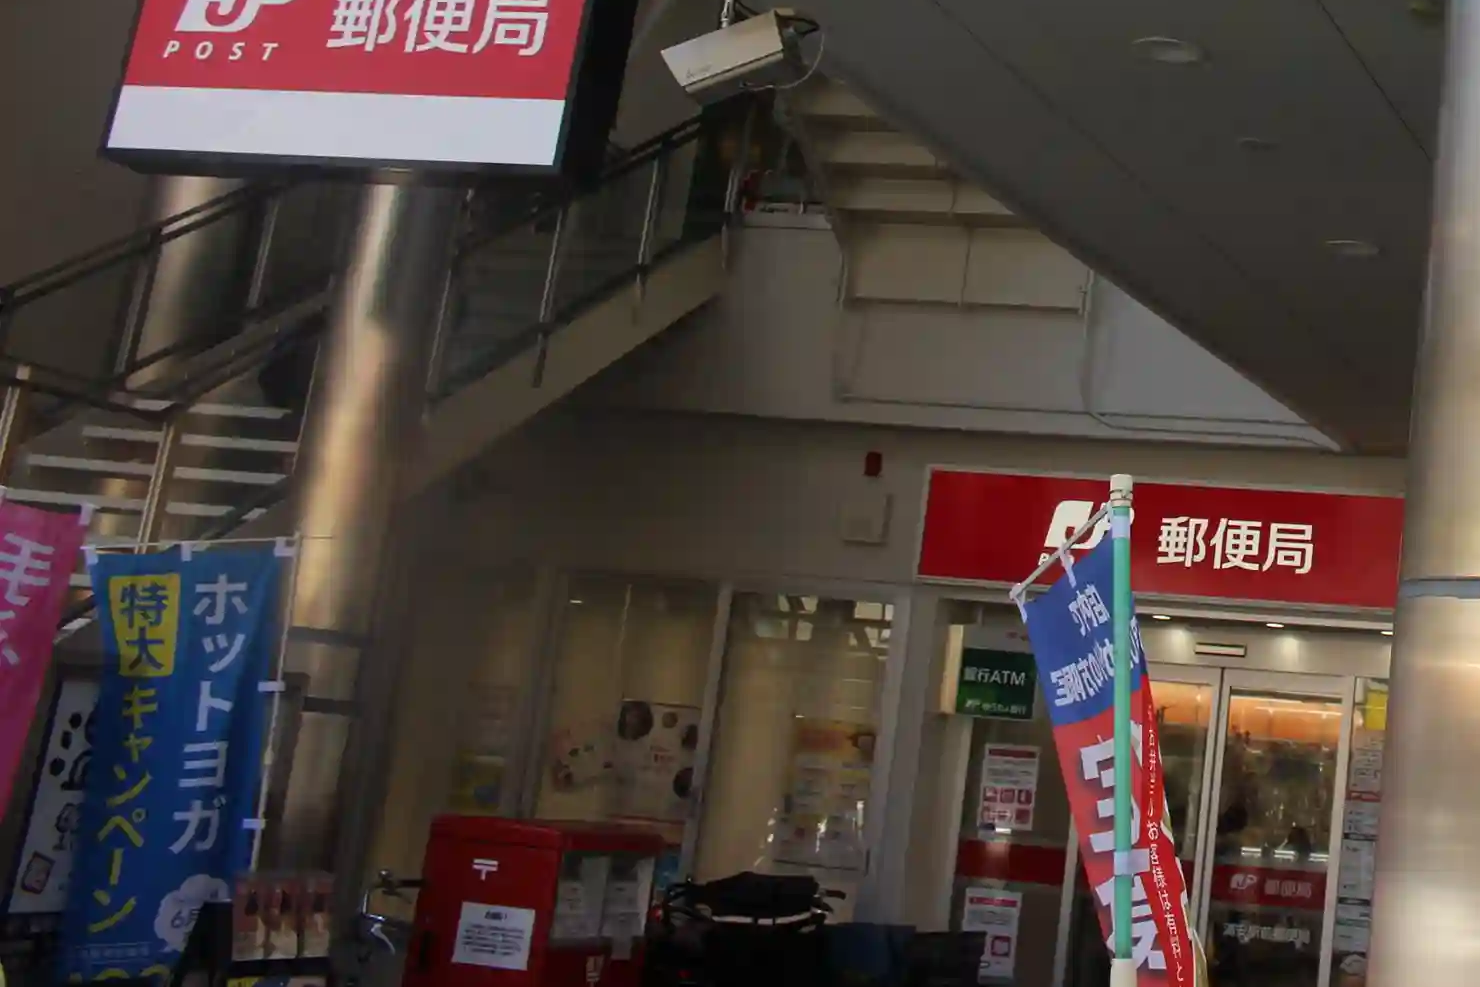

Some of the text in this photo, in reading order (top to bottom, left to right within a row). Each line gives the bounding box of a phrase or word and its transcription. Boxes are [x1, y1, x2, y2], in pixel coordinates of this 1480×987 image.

[163, 41, 278, 60] POST
[1157, 517, 1313, 574] 郵便局
[120, 583, 168, 671] 特大
[170, 573, 249, 853] ホットヨガ
[89, 686, 158, 933] キャンペーン
